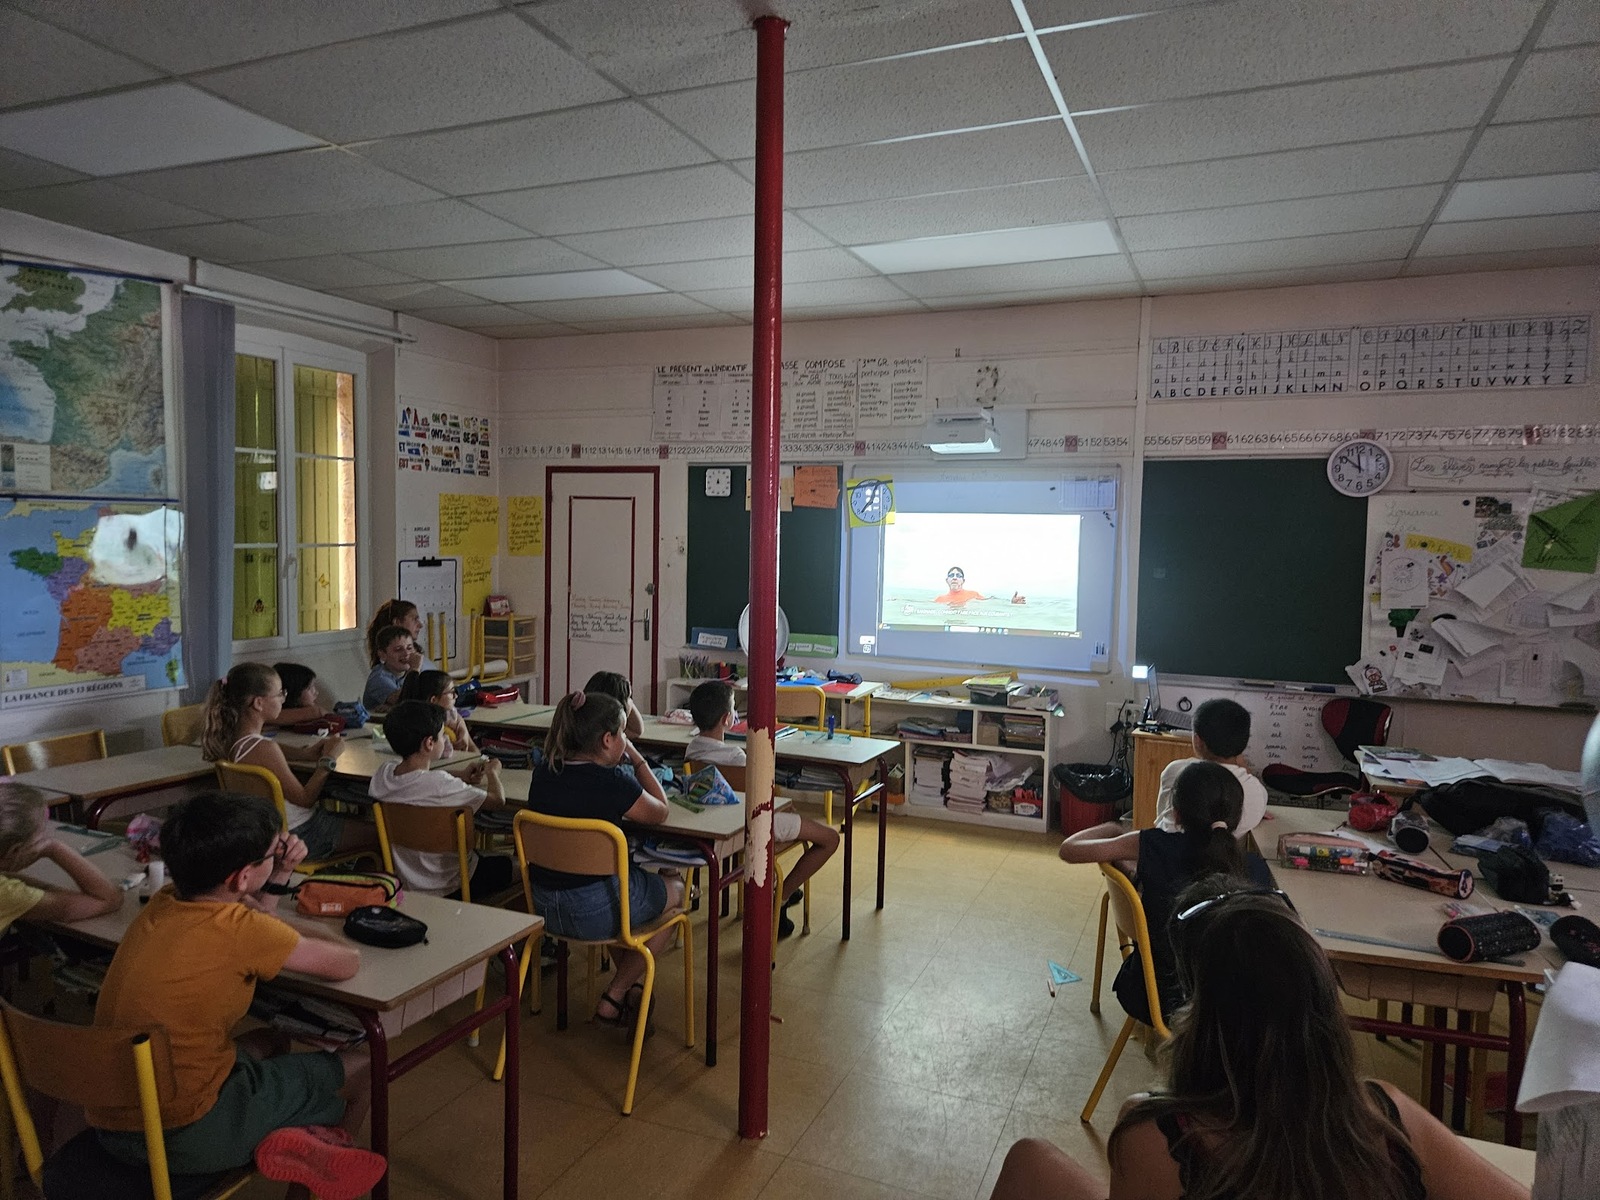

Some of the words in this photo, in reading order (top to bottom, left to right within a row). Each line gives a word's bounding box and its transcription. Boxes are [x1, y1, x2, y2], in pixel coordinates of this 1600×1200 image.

[657, 364, 666, 374] LE
[805, 360, 846, 369] COMPOSE
[861, 370, 890, 379] participes
[1360, 381, 1370, 391] O
[1379, 381, 1386, 390] P
[1396, 380, 1408, 390] Q
[1418, 379, 1426, 389] R
[1436, 378, 1444, 388] S
[1454, 378, 1462, 388] T
[1471, 377, 1480, 386] U
[1487, 376, 1497, 386] V
[1503, 376, 1518, 386] W
[1522, 375, 1532, 385] X
[1542, 374, 1550, 384] Y
[1564, 374, 1574, 384] Z
[1154, 390, 1162, 398] A
[1170, 389, 1176, 398] B
[1184, 388, 1192, 396] C
[1198, 388, 1206, 396] D
[1211, 388, 1217, 396] E
[1223, 387, 1230, 396] F
[1234, 386, 1244, 396] G
[1249, 386, 1258, 395] H
[1273, 384, 1280, 394] J
[1286, 384, 1294, 394] K
[1302, 384, 1308, 393] L
[1315, 383, 1326, 392] M
[1332, 382, 1343, 392] N
[1144, 435, 1157, 445] 55
[1158, 435, 1170, 445] 56
[1171, 435, 1184, 445] 57
[1184, 435, 1198, 444] 58
[1198, 435, 1211, 444] 59
[1227, 434, 1239, 444] 61
[1241, 434, 1254, 443] 62
[1255, 434, 1268, 443] 63
[1270, 433, 1282, 443] 64
[1285, 433, 1298, 443] 65
[1299, 433, 1312, 443] 66
[1314, 433, 1328, 442] 67
[1329, 433, 1344, 442] 68
[1345, 432, 1360, 442] 69
[1376, 431, 1390, 441] 71
[1391, 431, 1407, 441] 72
[1408, 430, 1422, 441] 73
[1424, 430, 1438, 441] 74
[1440, 430, 1456, 440] 75
[1456, 429, 1472, 440] 76
[1474, 429, 1490, 440] 77
[1490, 428, 1506, 440] 78
[1508, 428, 1523, 439] 79
[399, 442, 406, 452] ET
[783, 443, 792, 453] 33
[794, 443, 802, 452] 34
[803, 443, 812, 452] 35
[813, 442, 822, 452] 36
[824, 442, 834, 452] 37
[834, 442, 844, 452] 38
[844, 442, 854, 451] 39
[866, 441, 876, 451] 41
[876, 441, 886, 451] 42
[887, 441, 898, 450] 43
[898, 441, 908, 450] 44
[909, 441, 920, 450] 45
[1028, 438, 1040, 447] 47
[1040, 438, 1052, 447] 48
[1053, 438, 1064, 447] 49
[1078, 438, 1088, 447] 51
[1090, 437, 1102, 446] 52
[1104, 437, 1115, 446] 53
[1117, 437, 1128, 446] 54
[508, 446, 513, 454] 2
[516, 446, 520, 454] 3
[524, 446, 528, 454] 4
[532, 446, 536, 454] 5
[540, 446, 545, 454] 6
[548, 445, 554, 454] 7
[556, 445, 562, 454] 8
[564, 445, 570, 454] 9
[582, 445, 588, 454] 11
[589, 445, 597, 454] 12
[598, 445, 606, 454] 13
[608, 445, 616, 454] 14
[616, 445, 623, 454] 15
[625, 445, 632, 453] 16
[634, 445, 641, 453] 17
[643, 445, 650, 453] 18
[651, 444, 659, 453] 19
[668, 444, 676, 453] 21
[678, 444, 687, 453] 22
[687, 444, 696, 453] 23
[696, 444, 705, 453] 24
[706, 444, 715, 453] 25
[715, 444, 725, 453] 26
[724, 444, 734, 453] 27
[734, 444, 744, 453] 28
[1347, 447, 1354, 456] 11
[1355, 445, 1366, 454] 12
[1368, 447, 1372, 456] 1
[1375, 454, 1382, 462] 2
[1334, 464, 1341, 473] 9
[1378, 462, 1386, 472] 3
[1410, 457, 1436, 472] Les
[1531, 457, 1560, 471] petites
[1338, 474, 1344, 482] 8
[1374, 472, 1381, 480] 4
[1346, 479, 1353, 488] 7
[1356, 480, 1362, 490] 6
[1366, 479, 1374, 488] 5
[4, 694, 18, 704] LA
[18, 690, 56, 702] FRANCE
[58, 688, 74, 697] DES
[76, 686, 85, 694] 13
[87, 680, 124, 693] RÉGIONS
